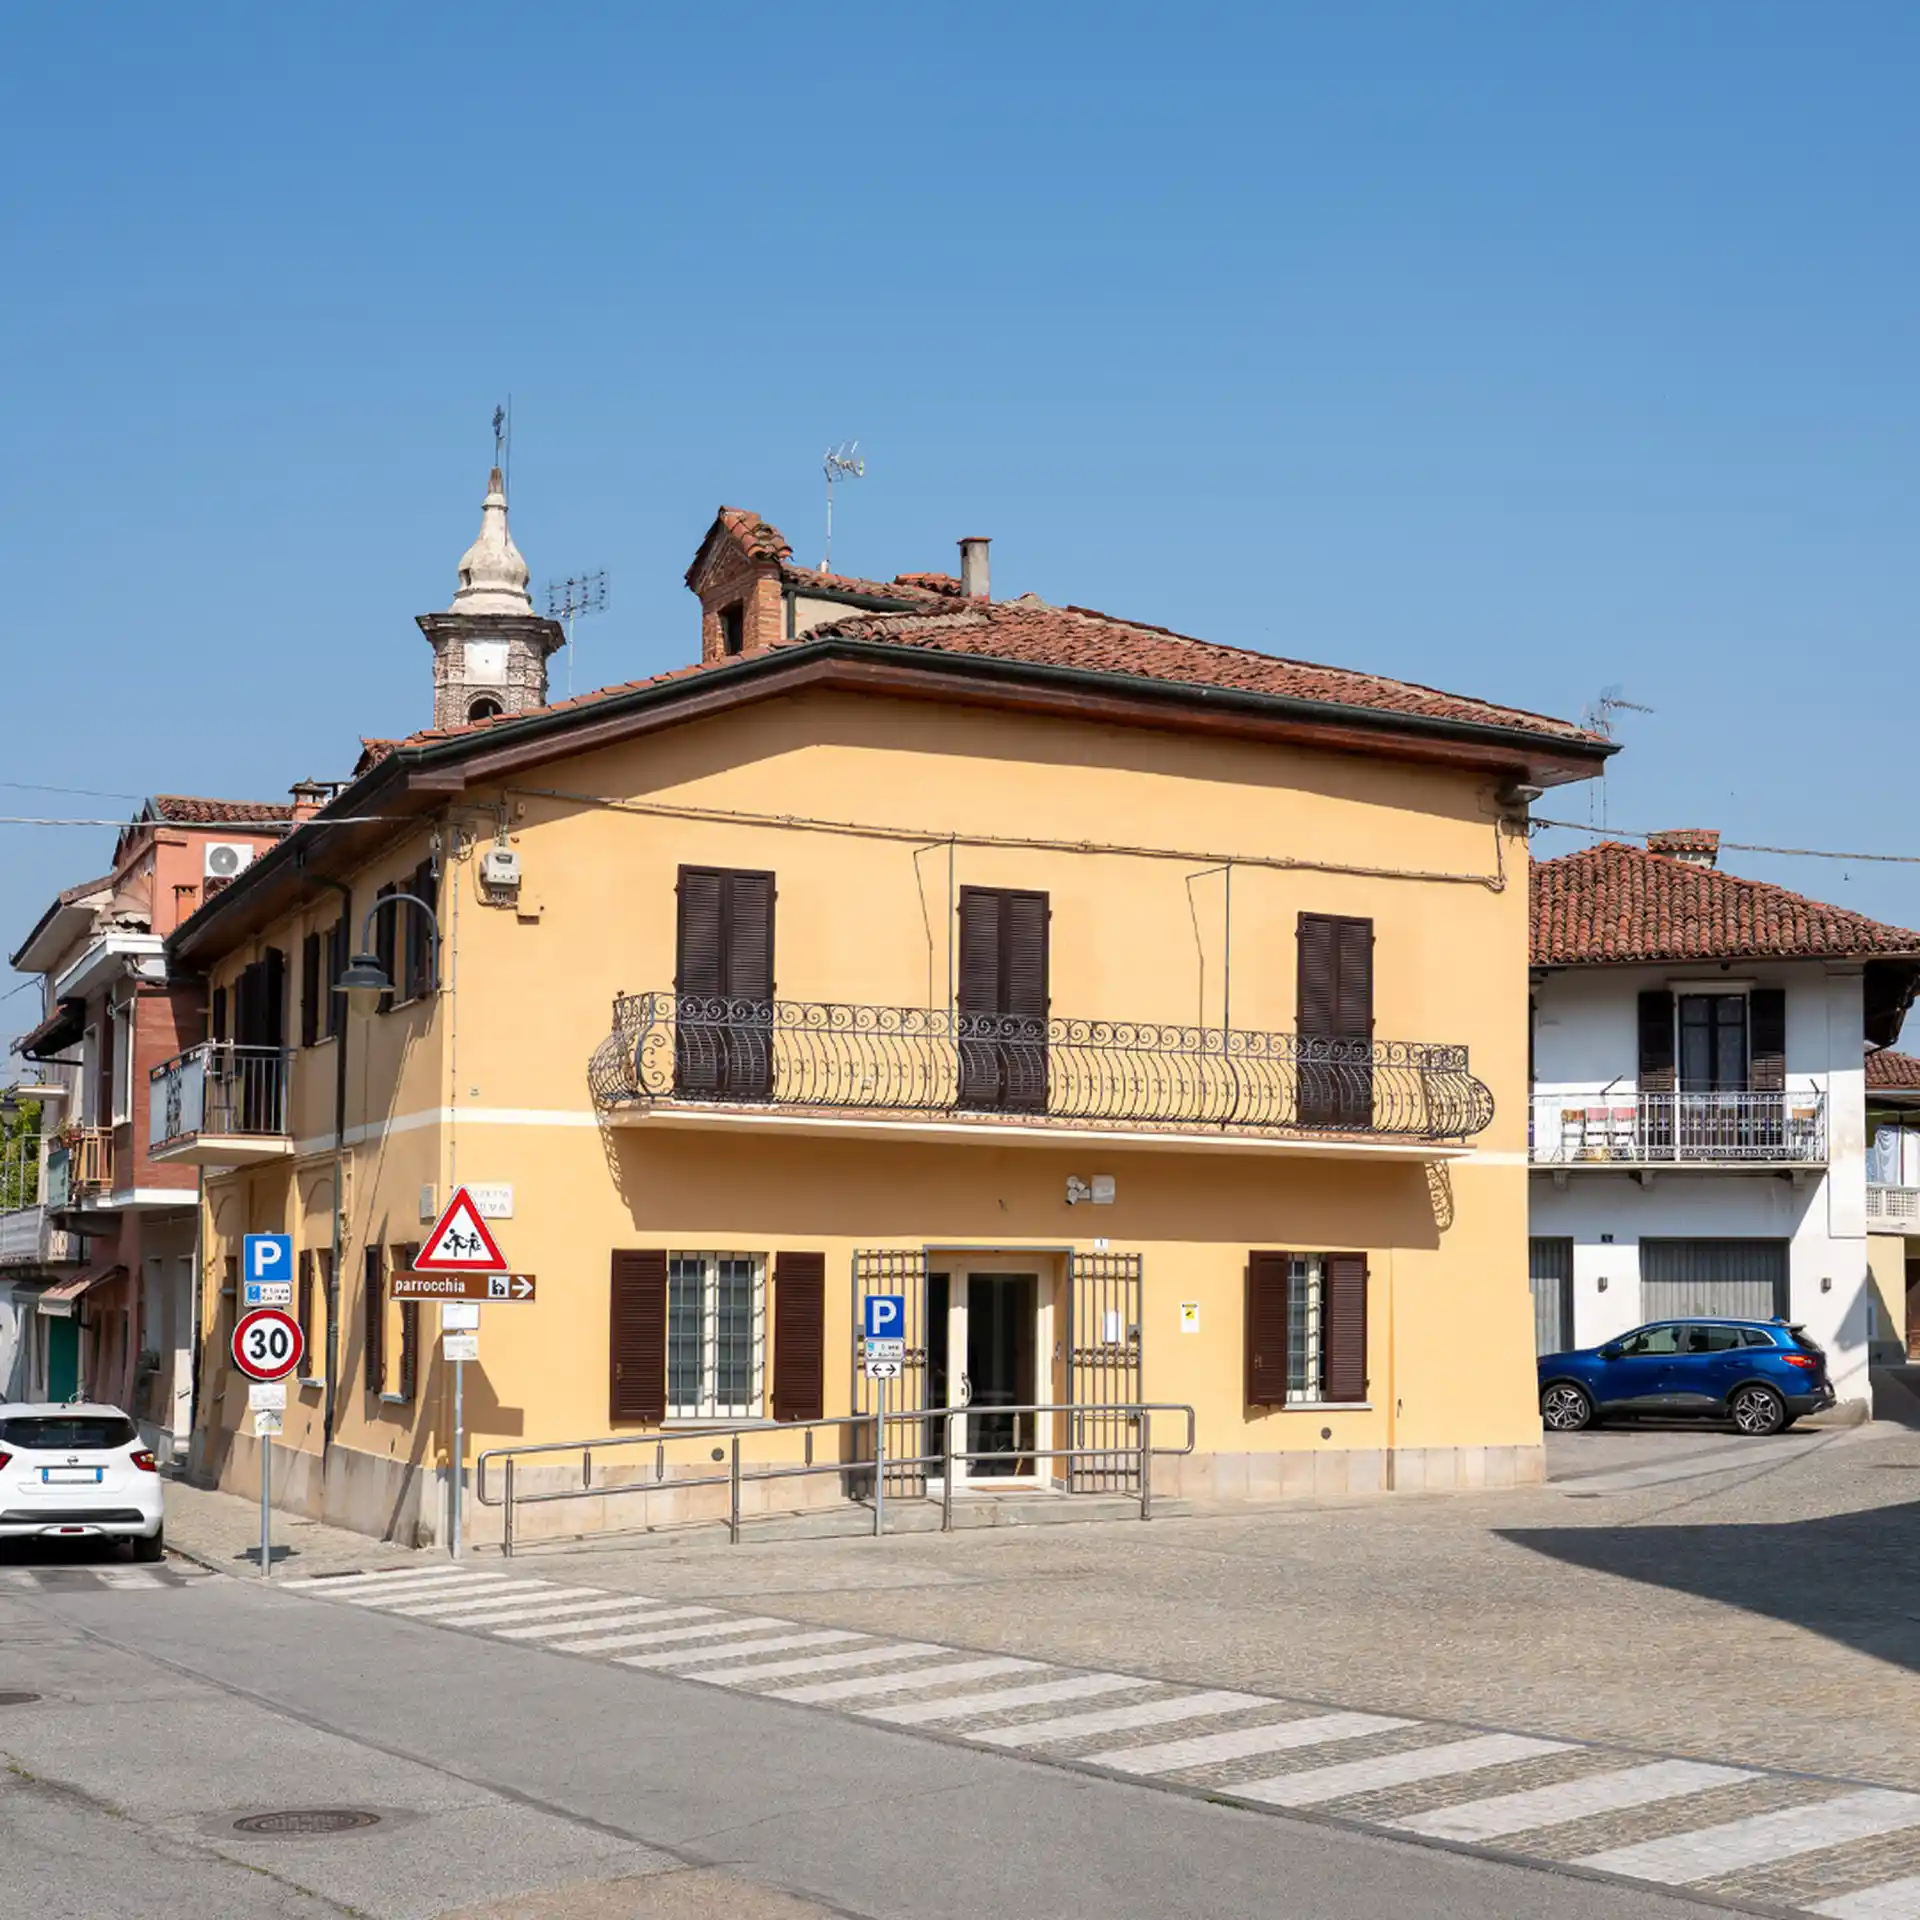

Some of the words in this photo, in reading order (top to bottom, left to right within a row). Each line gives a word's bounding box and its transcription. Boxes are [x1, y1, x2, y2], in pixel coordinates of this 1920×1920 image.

[254, 1240, 282, 1276] P
[394, 1277, 466, 1295] parrocchia
[872, 1299, 897, 1334] P
[249, 1327, 289, 1360] 30
